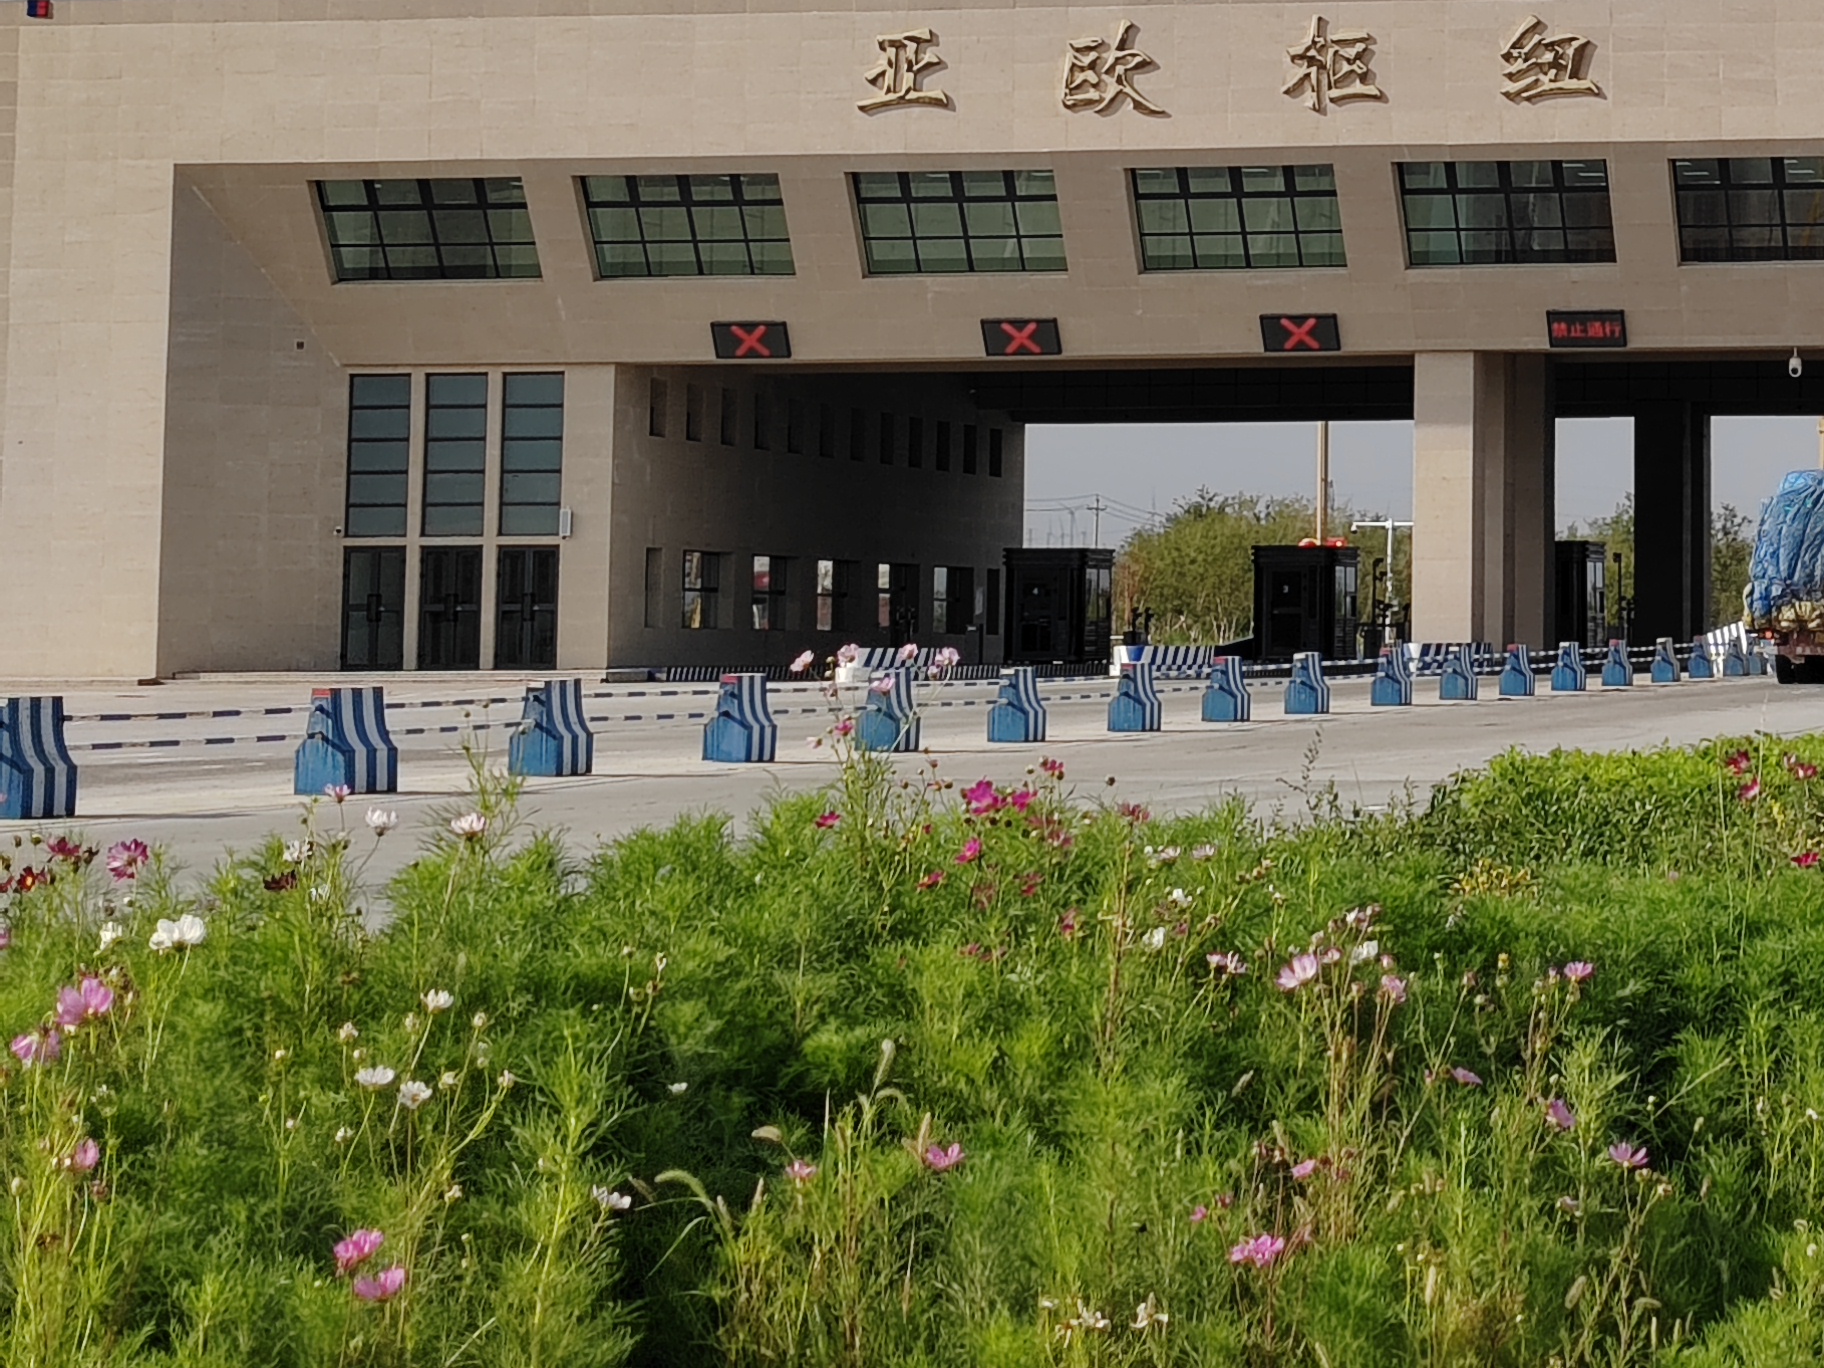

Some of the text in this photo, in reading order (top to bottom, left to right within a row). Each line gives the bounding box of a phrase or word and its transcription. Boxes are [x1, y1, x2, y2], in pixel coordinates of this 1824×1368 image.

[856, 14, 1606, 116] 亚欧枢纽
[1551, 321, 1622, 338] 禁止通行
